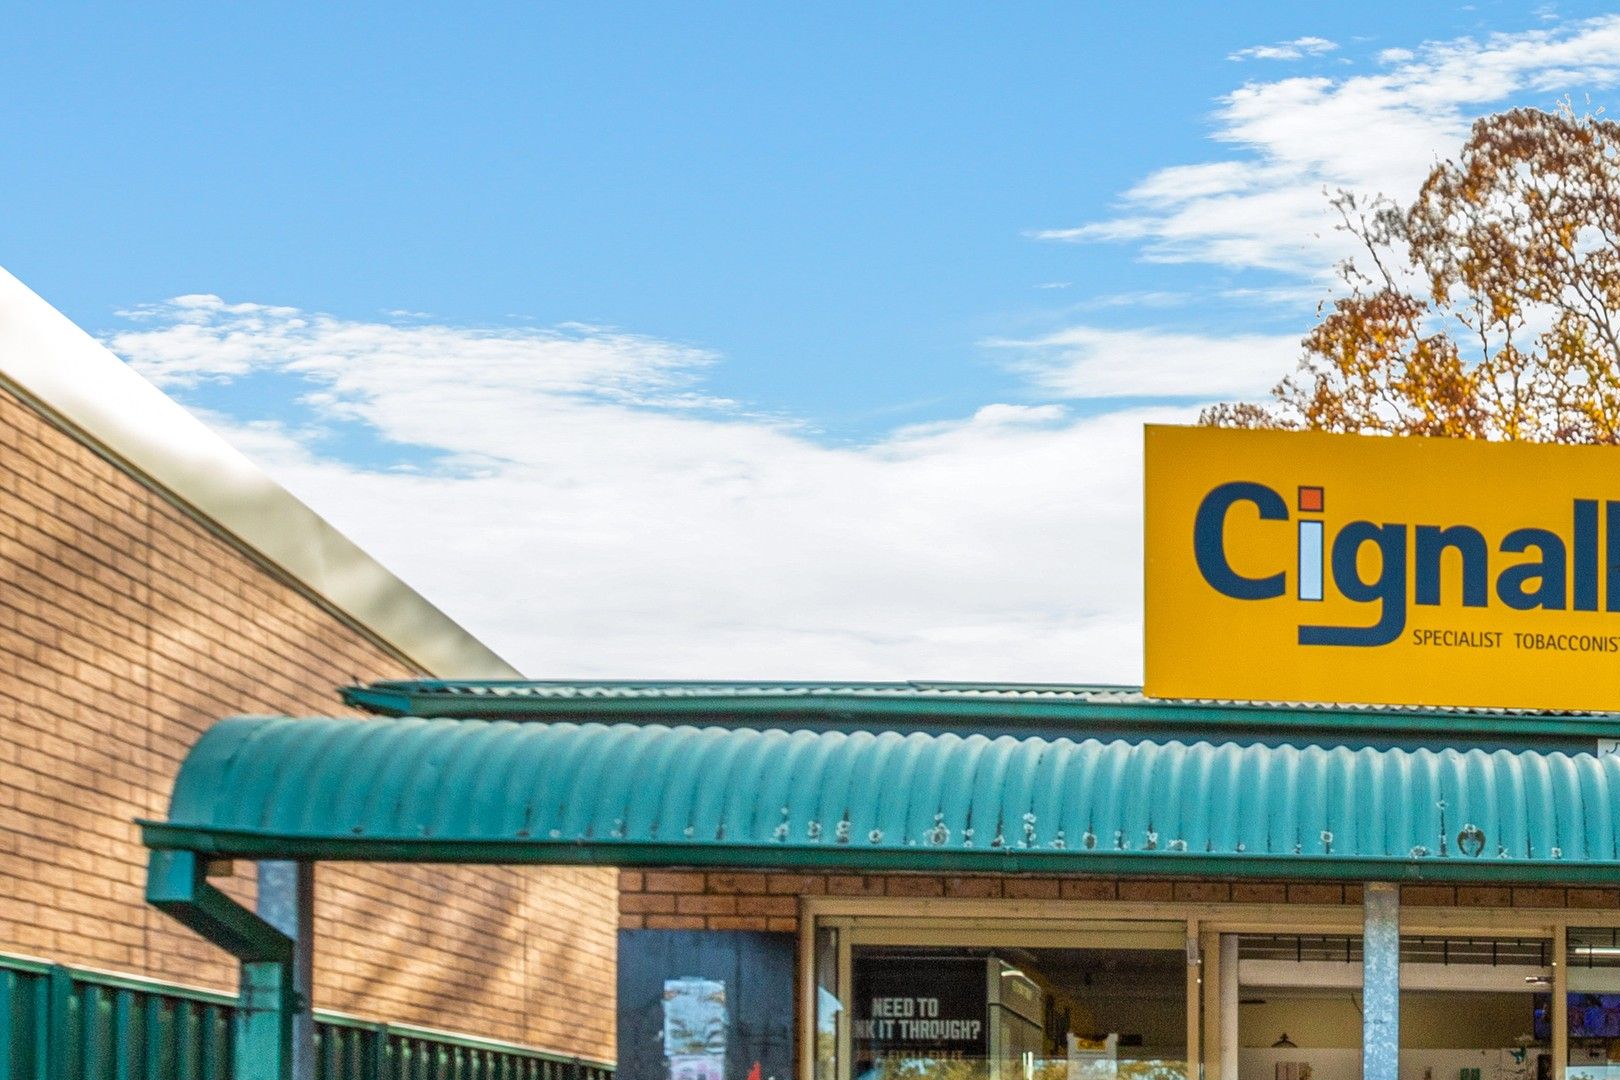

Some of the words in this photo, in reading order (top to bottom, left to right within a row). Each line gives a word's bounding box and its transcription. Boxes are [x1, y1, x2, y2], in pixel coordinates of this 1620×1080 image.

[1413, 629, 1503, 648] SPECIALIST
[872, 998, 914, 1017] NEED
[917, 998, 939, 1017] TO
[879, 1020, 895, 1039] IT
[898, 1020, 981, 1039] THROUGH?
